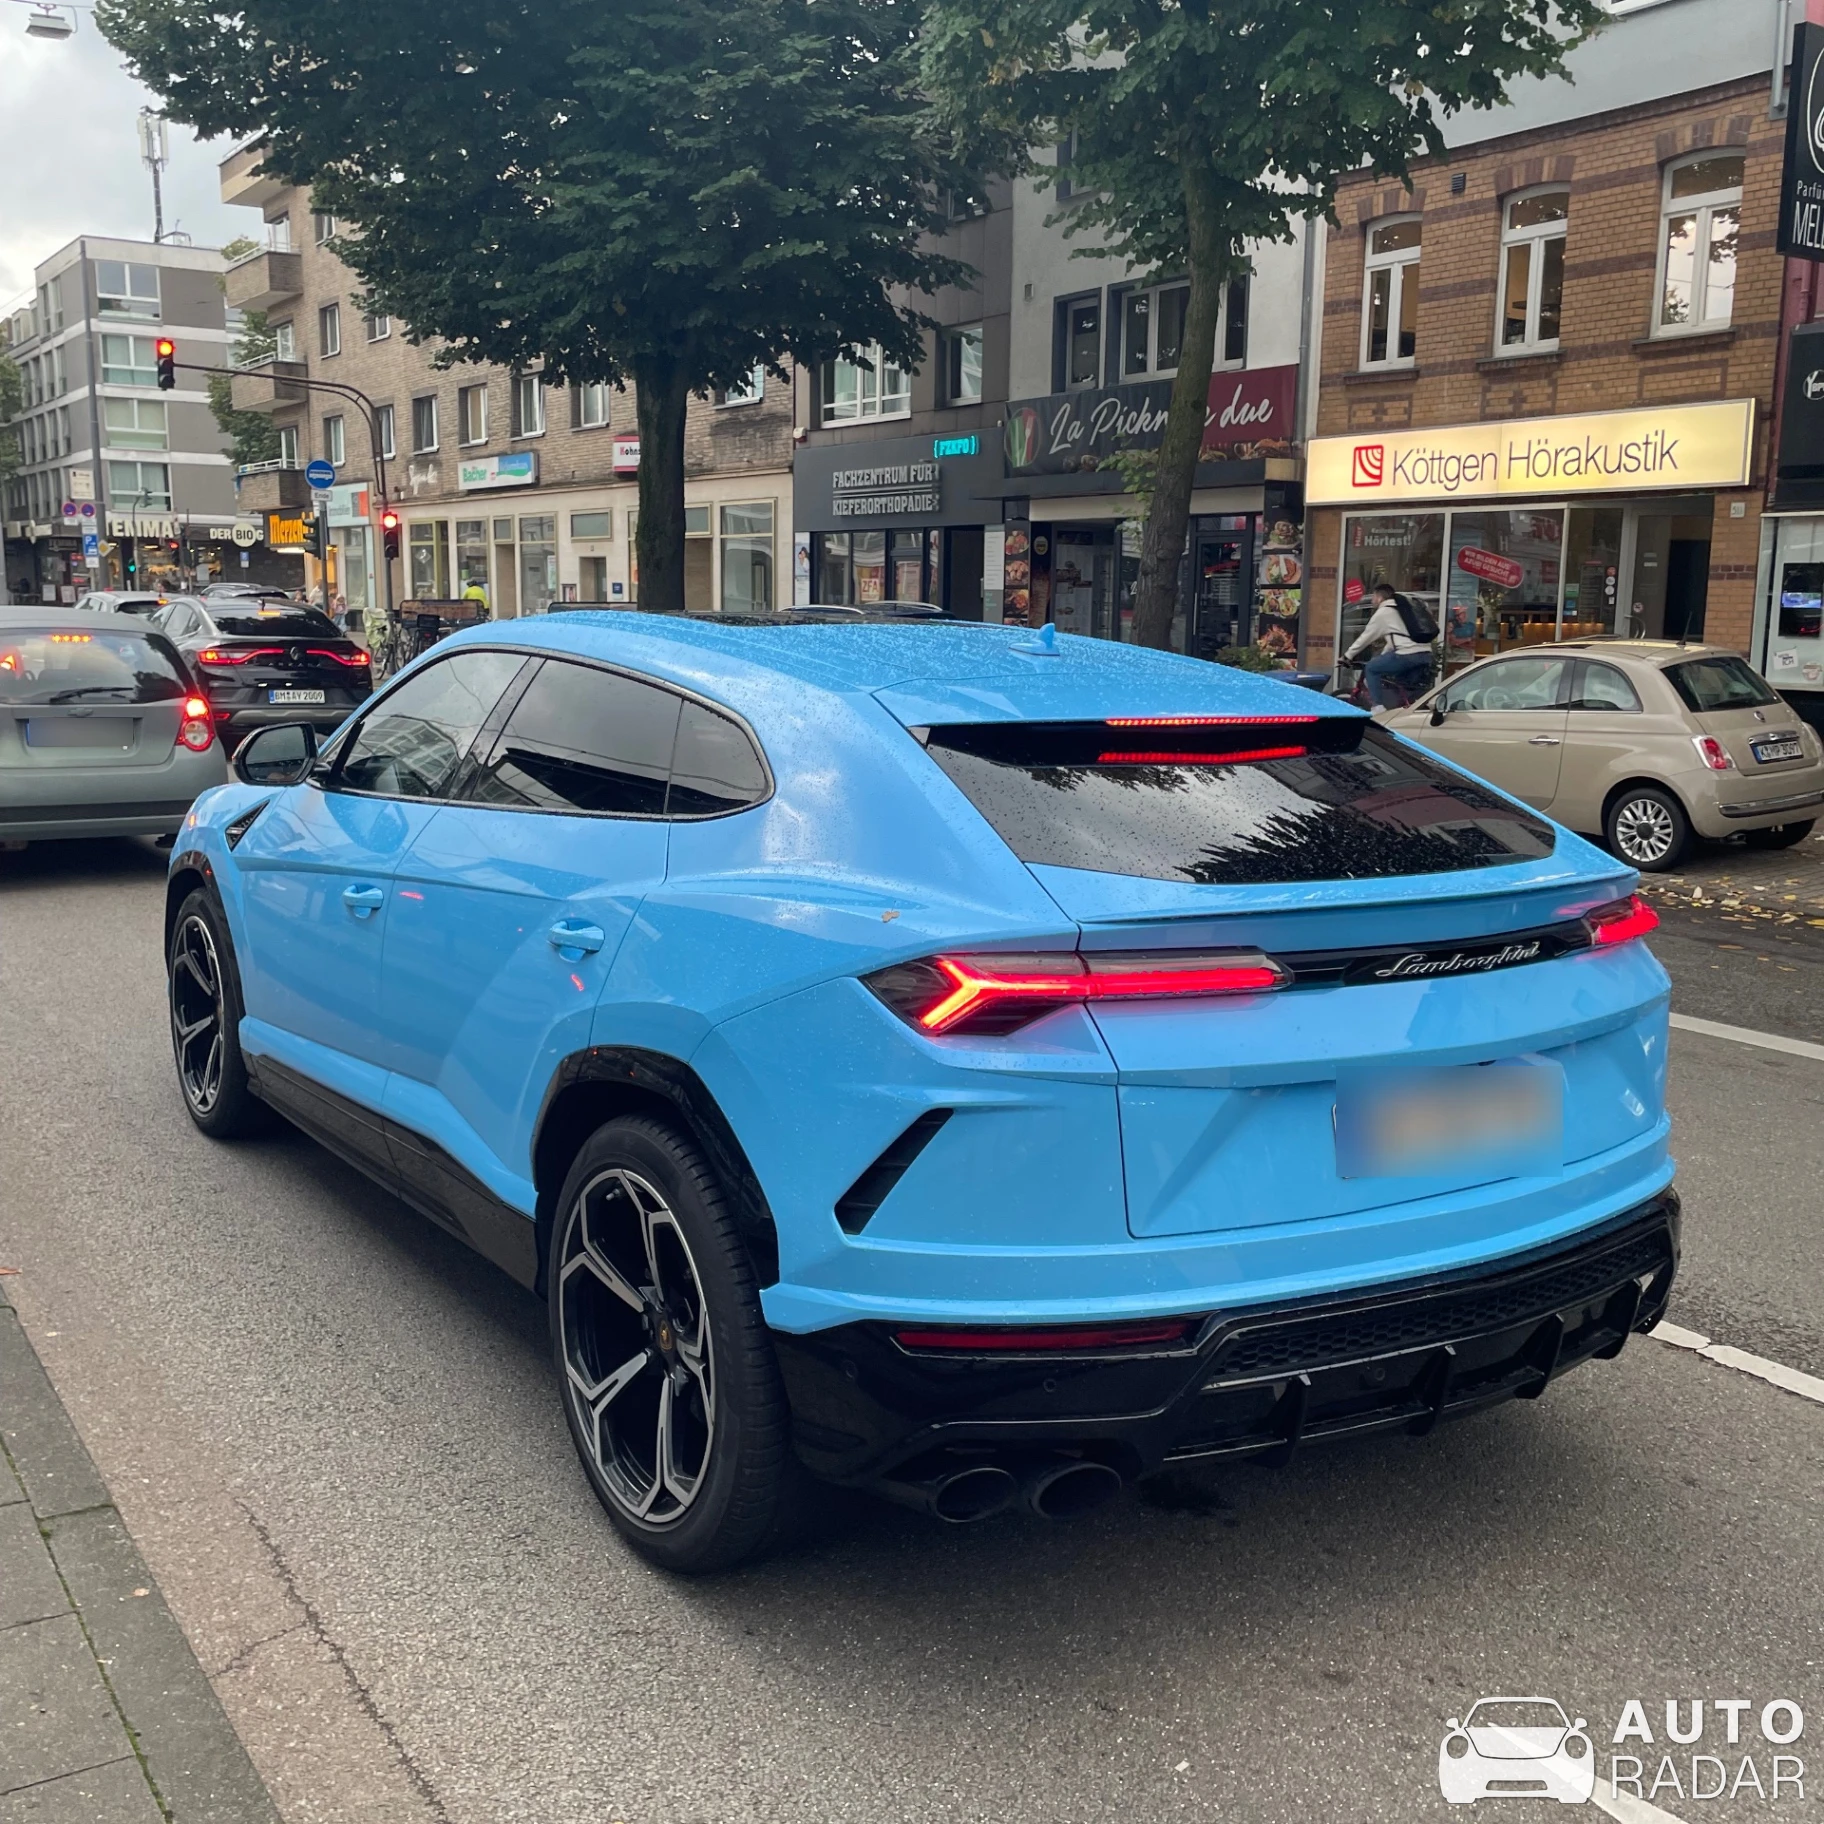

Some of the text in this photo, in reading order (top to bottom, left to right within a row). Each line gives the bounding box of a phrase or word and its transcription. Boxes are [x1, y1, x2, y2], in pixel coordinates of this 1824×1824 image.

[1796, 180, 1824, 200] Parfü
[1049, 402, 1085, 454] La
[1220, 383, 1274, 428] due
[1393, 429, 1679, 491] Köttgen Hörakustik
[833, 466, 908, 488] FACHZENTRUM
[833, 491, 933, 516] KIEFERORTHOPÄDIE
[210, 528, 264, 540] DER BIO G
[269, 512, 314, 545] Merzen
[1364, 535, 1412, 547] Hörtest!
[862, 580, 879, 592] ZFA
[1375, 941, 1541, 977] Lamborghini
